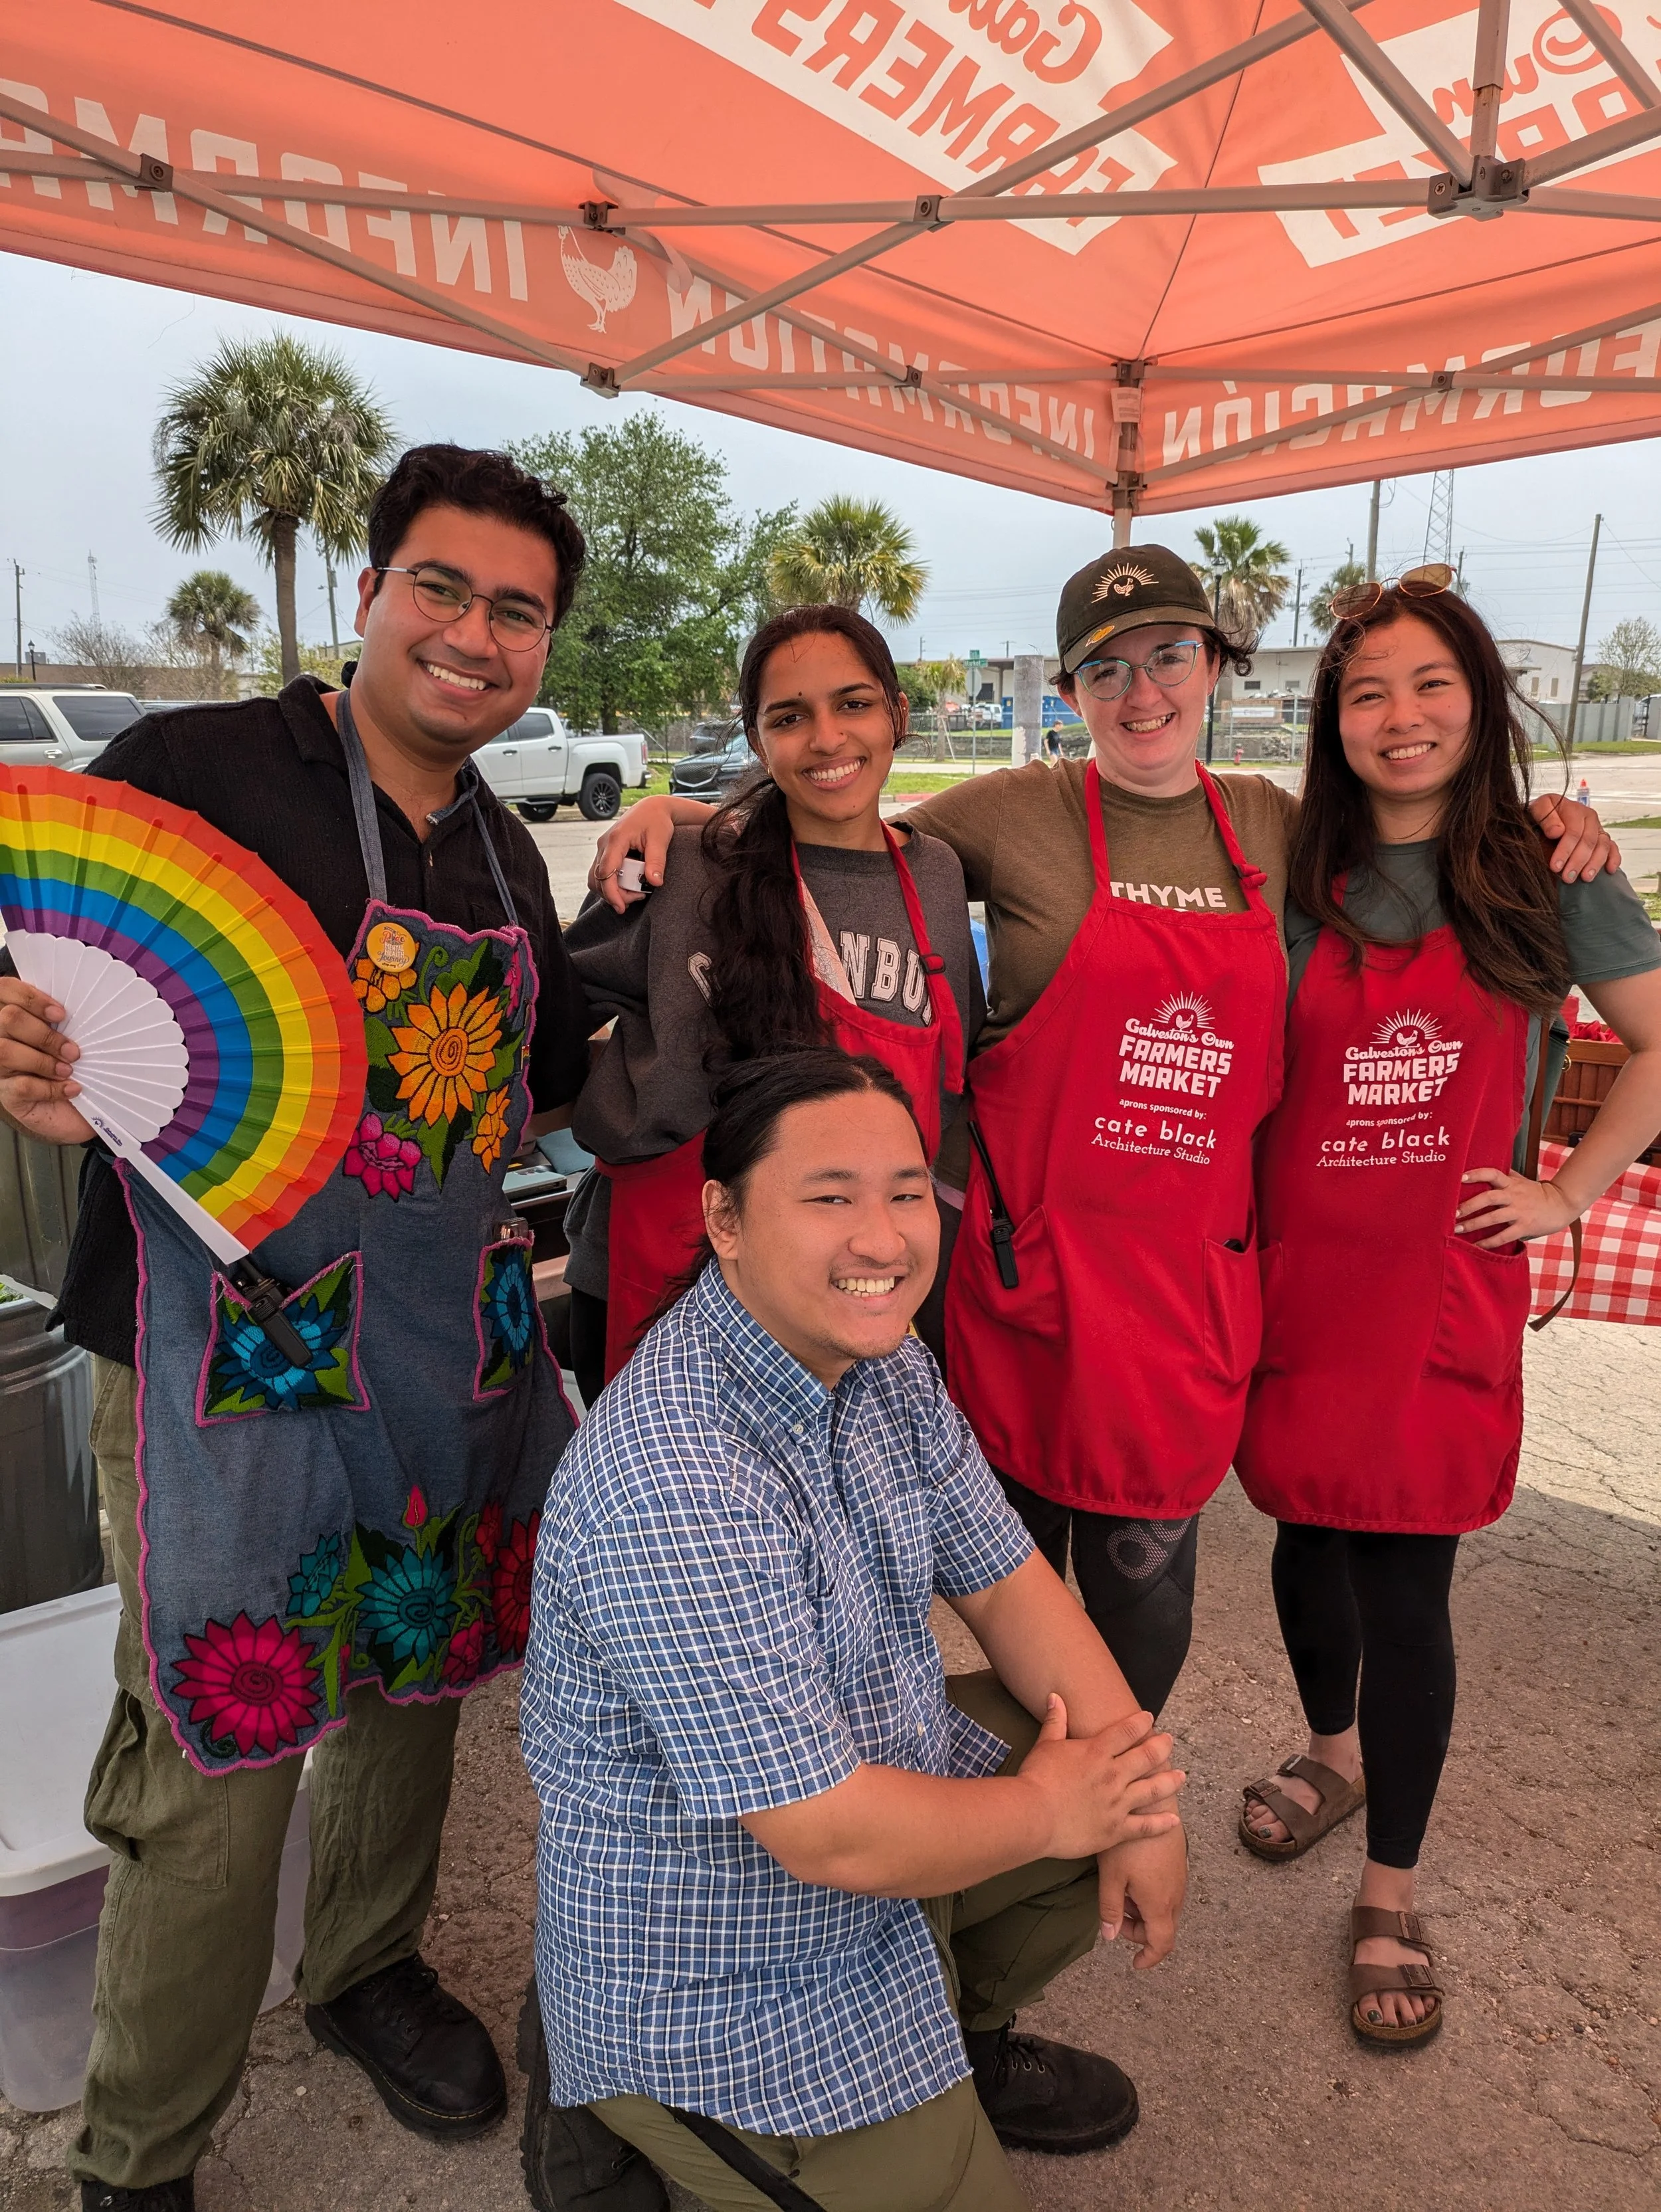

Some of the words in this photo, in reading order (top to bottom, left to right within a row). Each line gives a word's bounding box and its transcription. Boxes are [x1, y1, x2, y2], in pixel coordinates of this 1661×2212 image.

[1110, 881, 1226, 908] THYME
[1201, 1031, 1234, 1050] Own
[1428, 1040, 1464, 1054] Own
[1119, 1035, 1232, 1075] FARMERS
[1343, 1053, 1460, 1083] FARMERS
[1119, 1060, 1222, 1098] MARKET
[1347, 1076, 1448, 1106] MARKET
[1119, 1098, 1147, 1110] aprons
[1149, 1104, 1193, 1117] sponsored
[1194, 1110, 1207, 1120] by:
[1346, 1119, 1375, 1128] aprons
[1376, 1113, 1417, 1128] sponsored
[1418, 1111, 1433, 1120] by:
[1094, 1116, 1148, 1137] cate
[1159, 1120, 1217, 1149] black
[1321, 1136, 1369, 1152] cate
[1381, 1126, 1450, 1150] black
[1090, 1132, 1171, 1156] Architecture
[1173, 1147, 1211, 1165] Studio
[1316, 1154, 1397, 1167] Architecture
[1401, 1150, 1446, 1163] Studio
